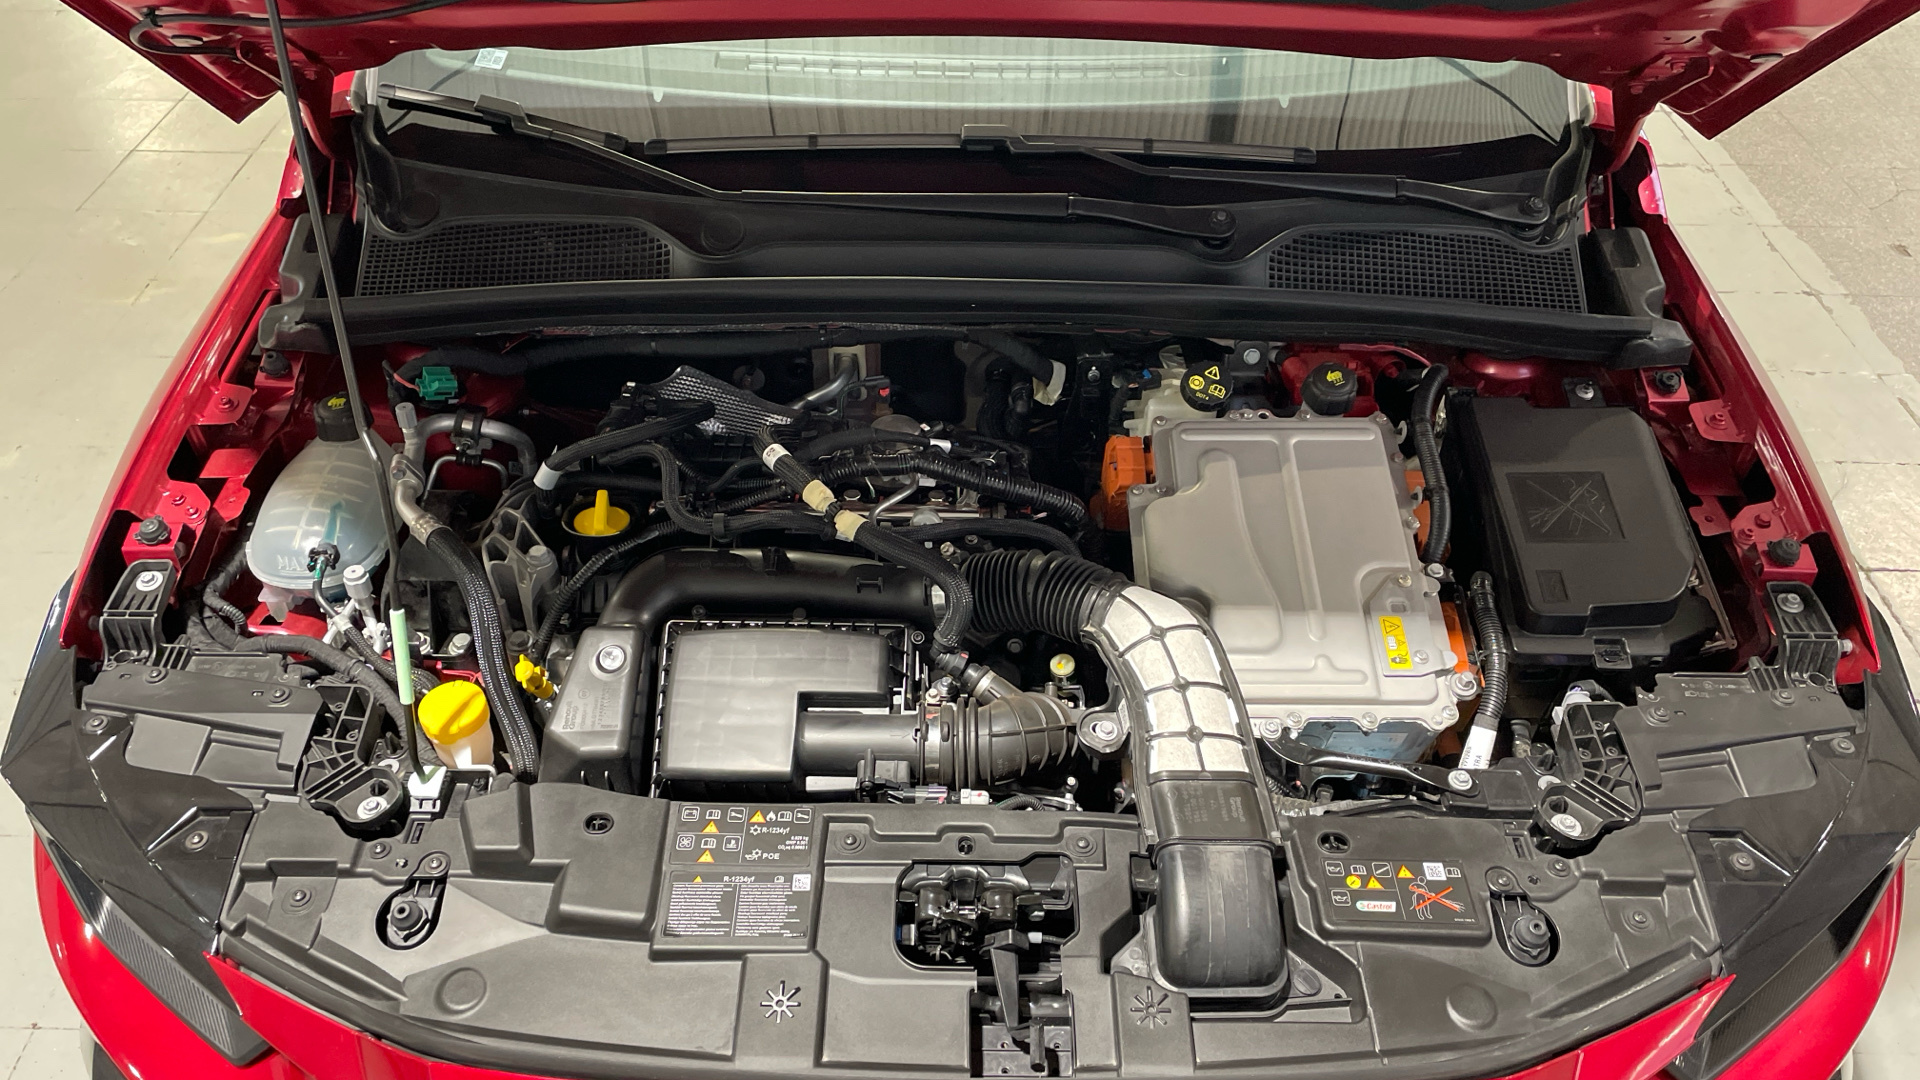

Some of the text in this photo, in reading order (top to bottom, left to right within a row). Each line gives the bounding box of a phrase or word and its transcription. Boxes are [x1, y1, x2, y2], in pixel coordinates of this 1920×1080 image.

[569, 705, 579, 730] Group
[761, 826, 790, 835] R-1234yf
[762, 852, 780, 860] POE
[723, 875, 755, 883] R-1234yf
[1366, 902, 1393, 910] Castrol
